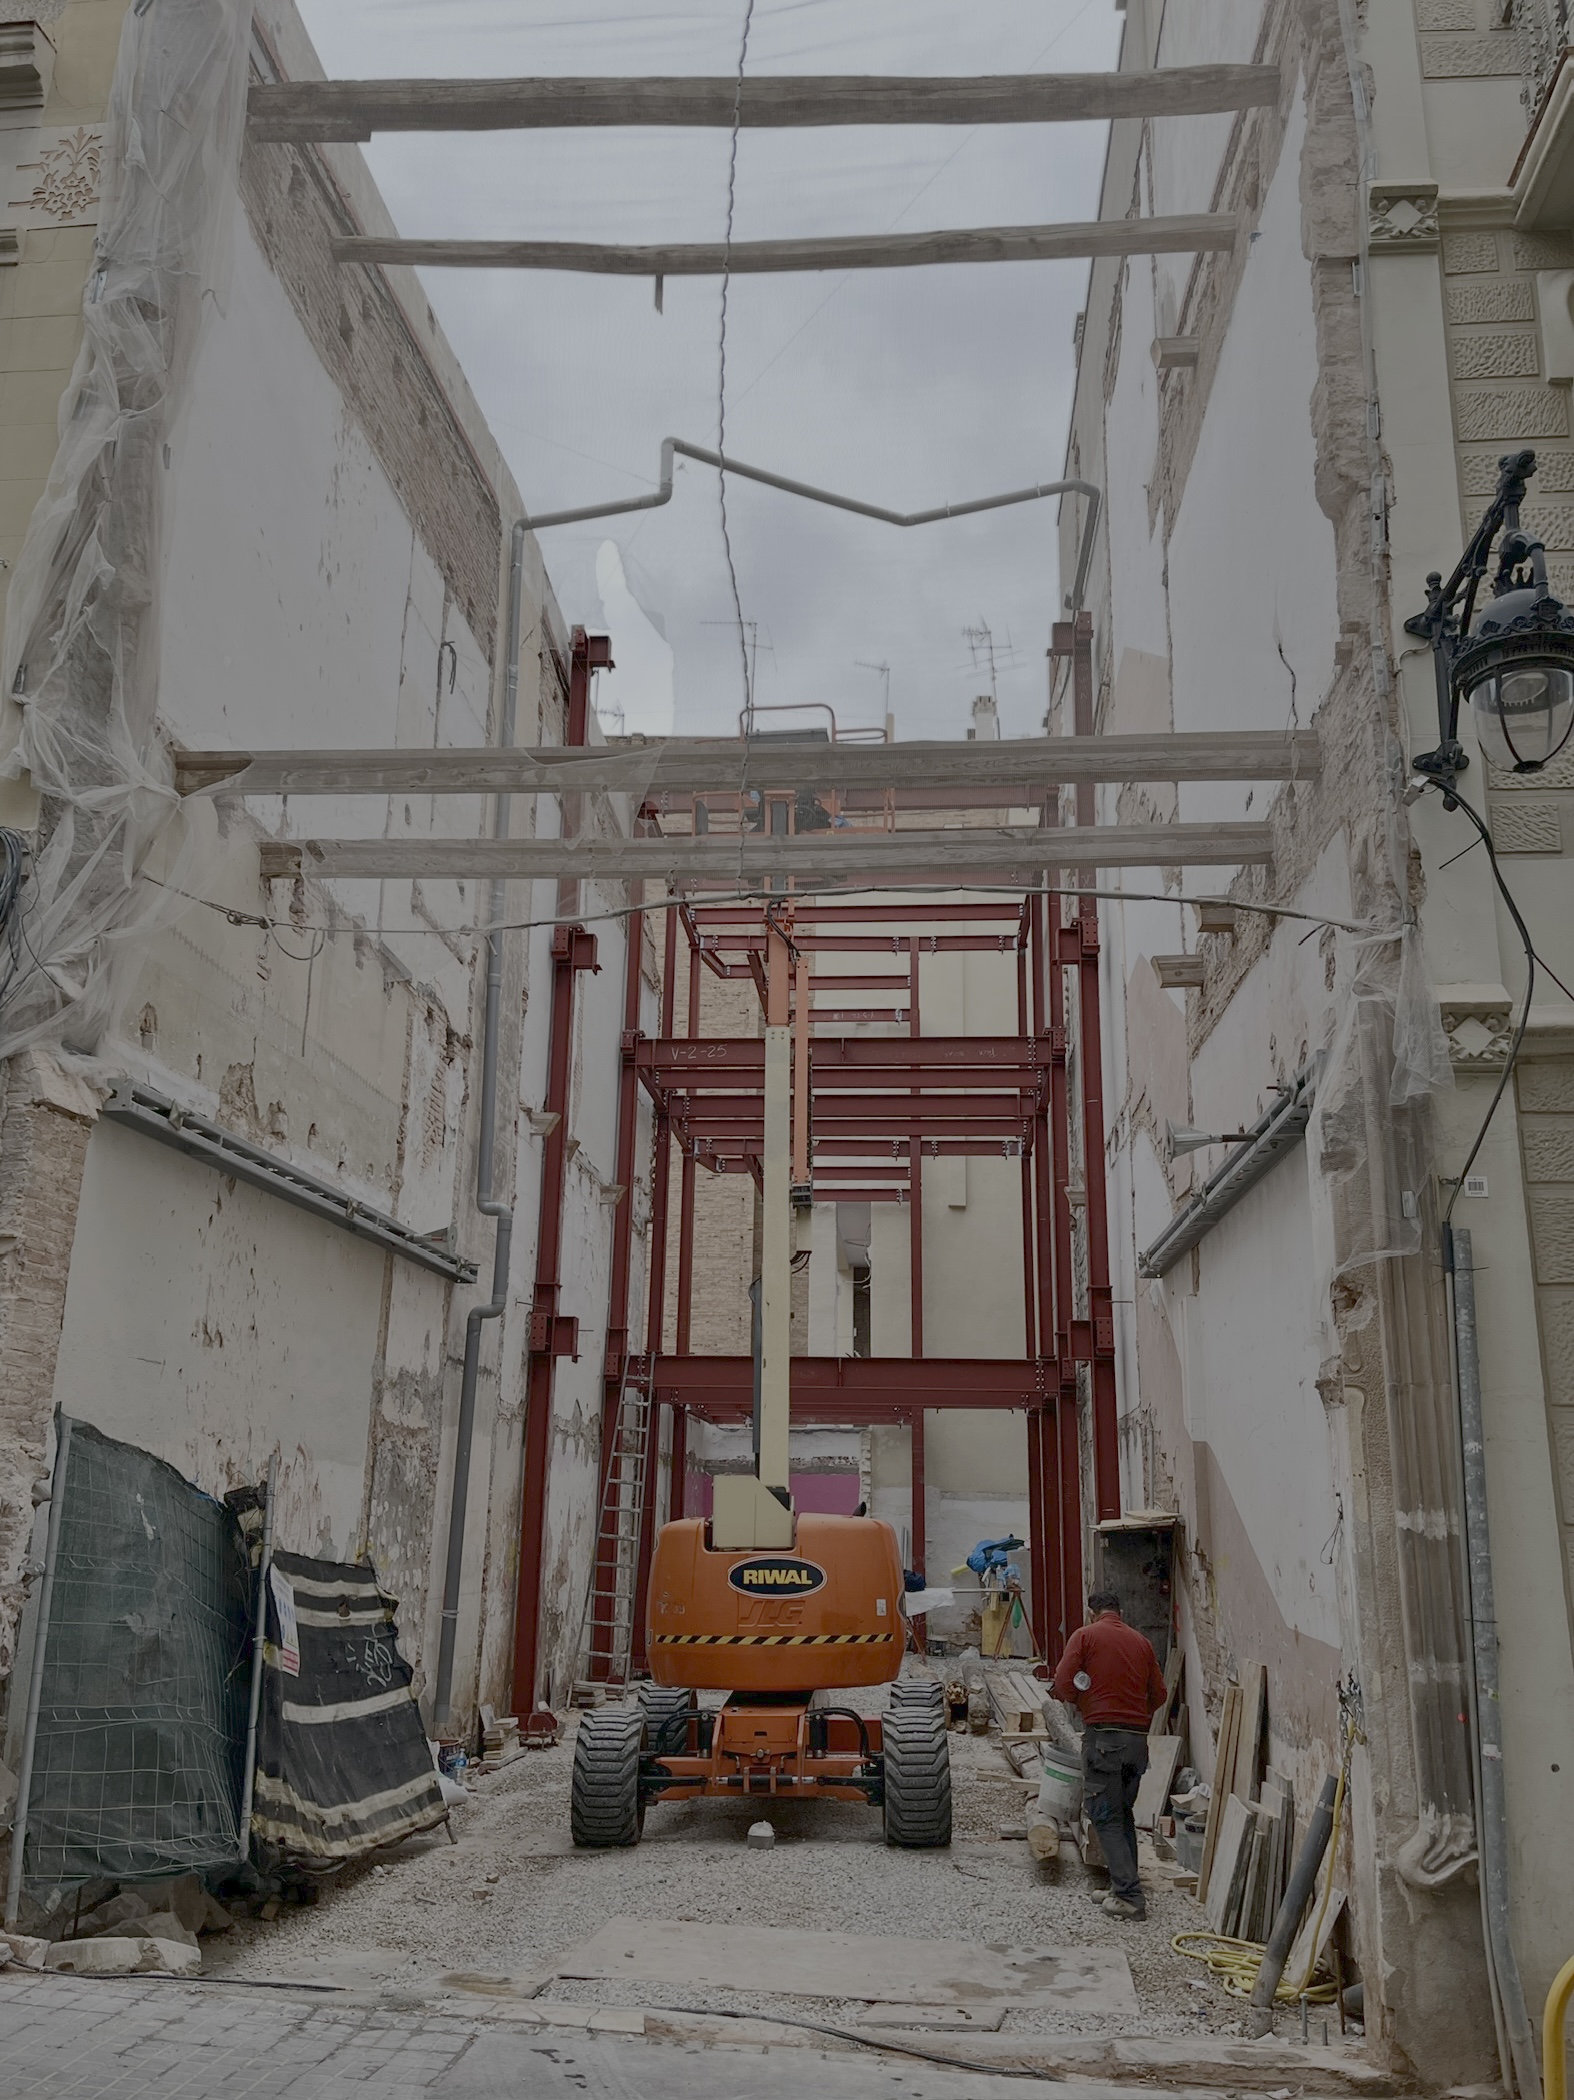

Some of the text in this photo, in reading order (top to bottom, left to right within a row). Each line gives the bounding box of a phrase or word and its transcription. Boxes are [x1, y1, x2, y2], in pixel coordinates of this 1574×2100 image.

[671, 1043, 728, 1061] V-2-25
[743, 1569, 813, 1585] RIWAL
[738, 1600, 806, 1627] JLG
